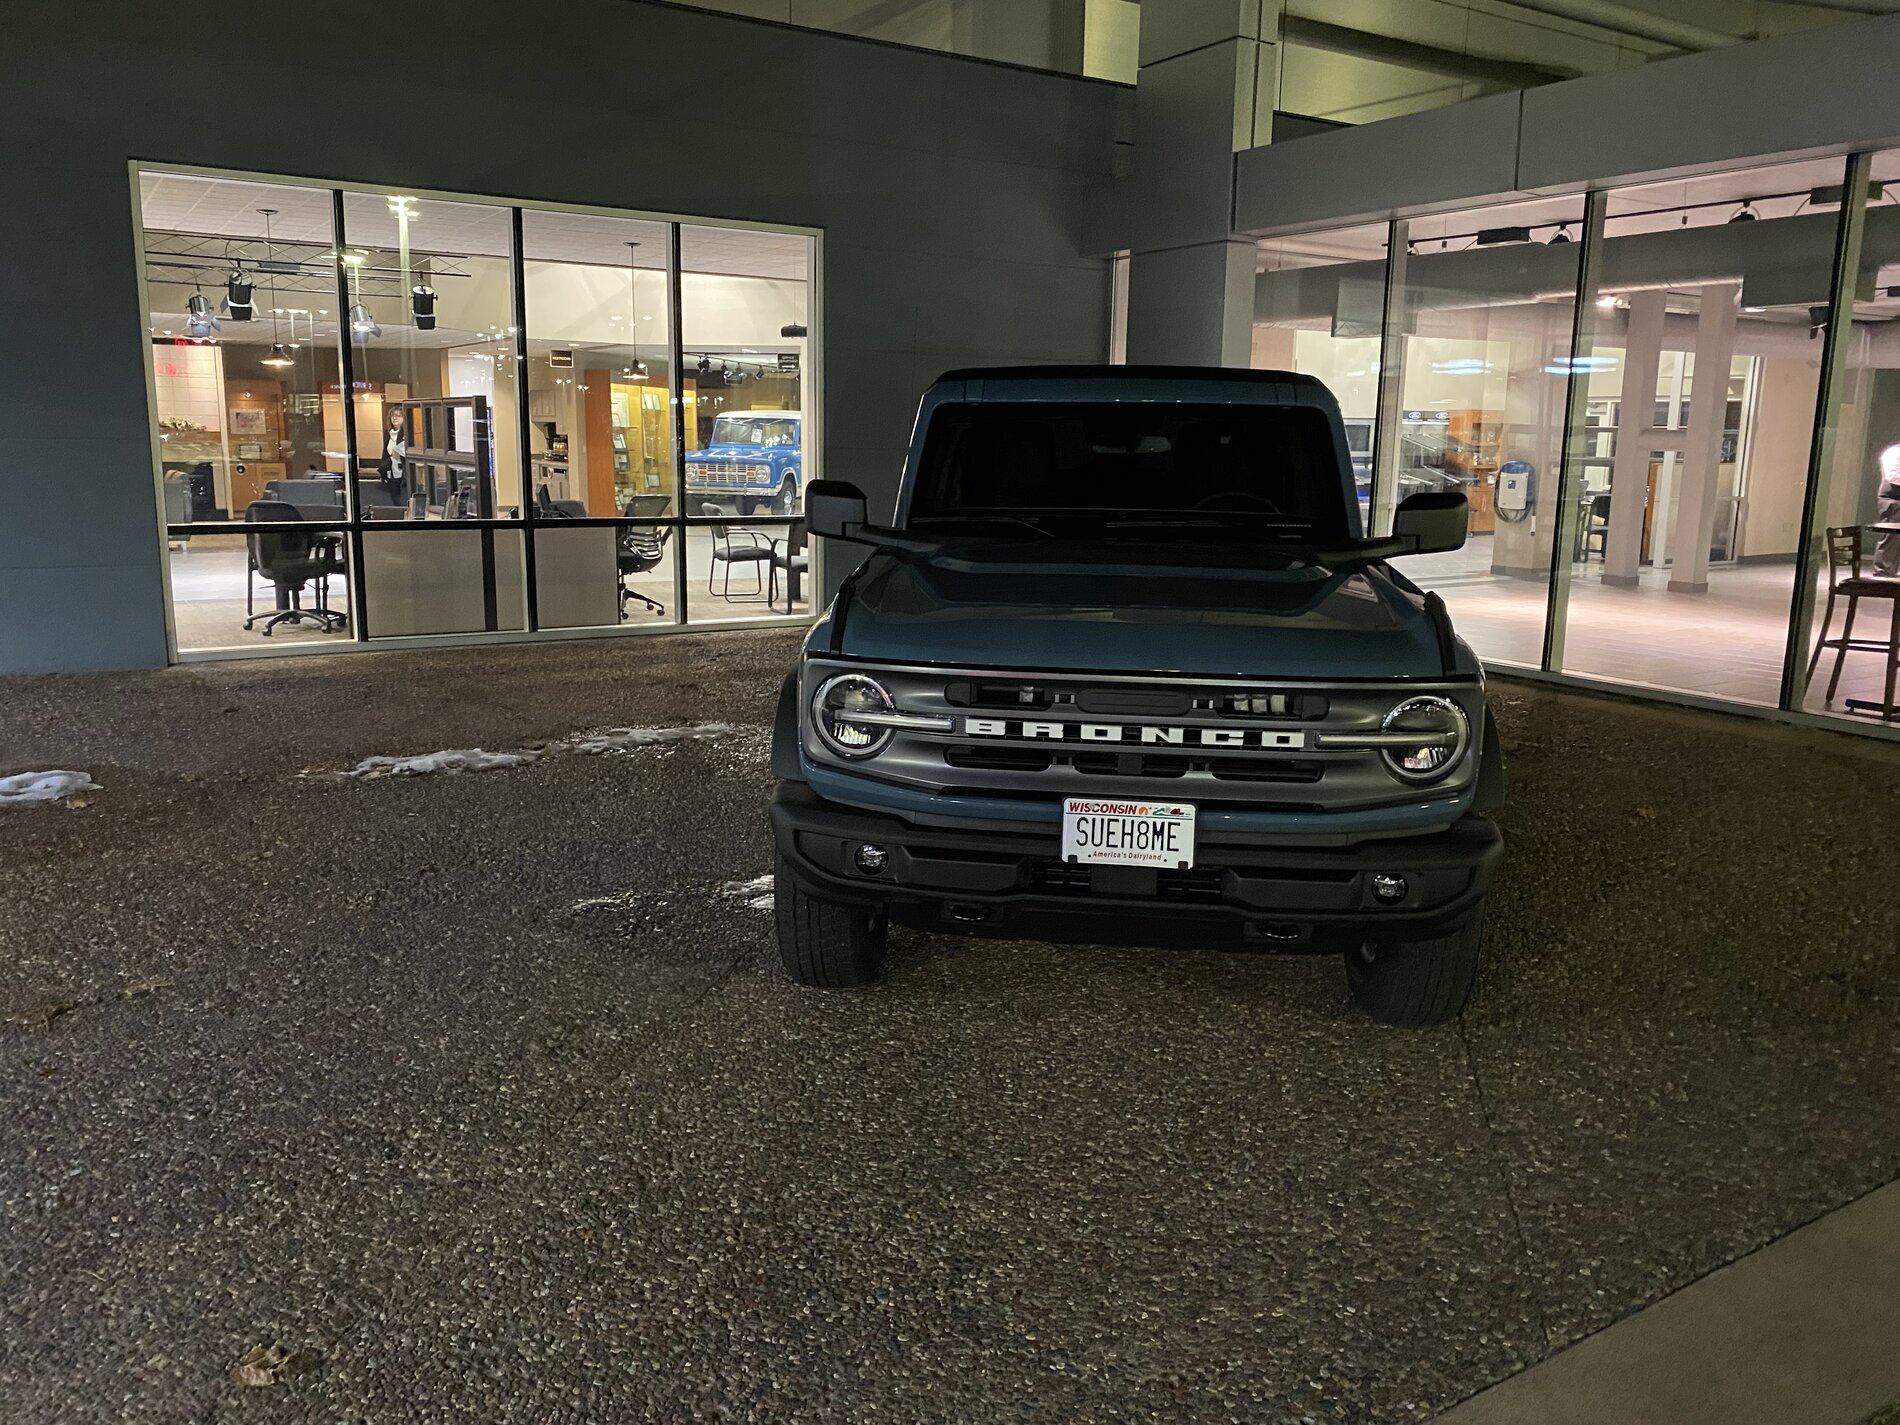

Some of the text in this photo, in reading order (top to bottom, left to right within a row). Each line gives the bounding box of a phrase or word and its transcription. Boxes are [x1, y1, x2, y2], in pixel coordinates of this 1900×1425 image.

[965, 718, 1305, 748] BRONCO
[1070, 802, 1137, 815] WISCONSIN
[1076, 817, 1181, 852] SUEH8ME
[1093, 850, 1162, 861] America's Dairyland
